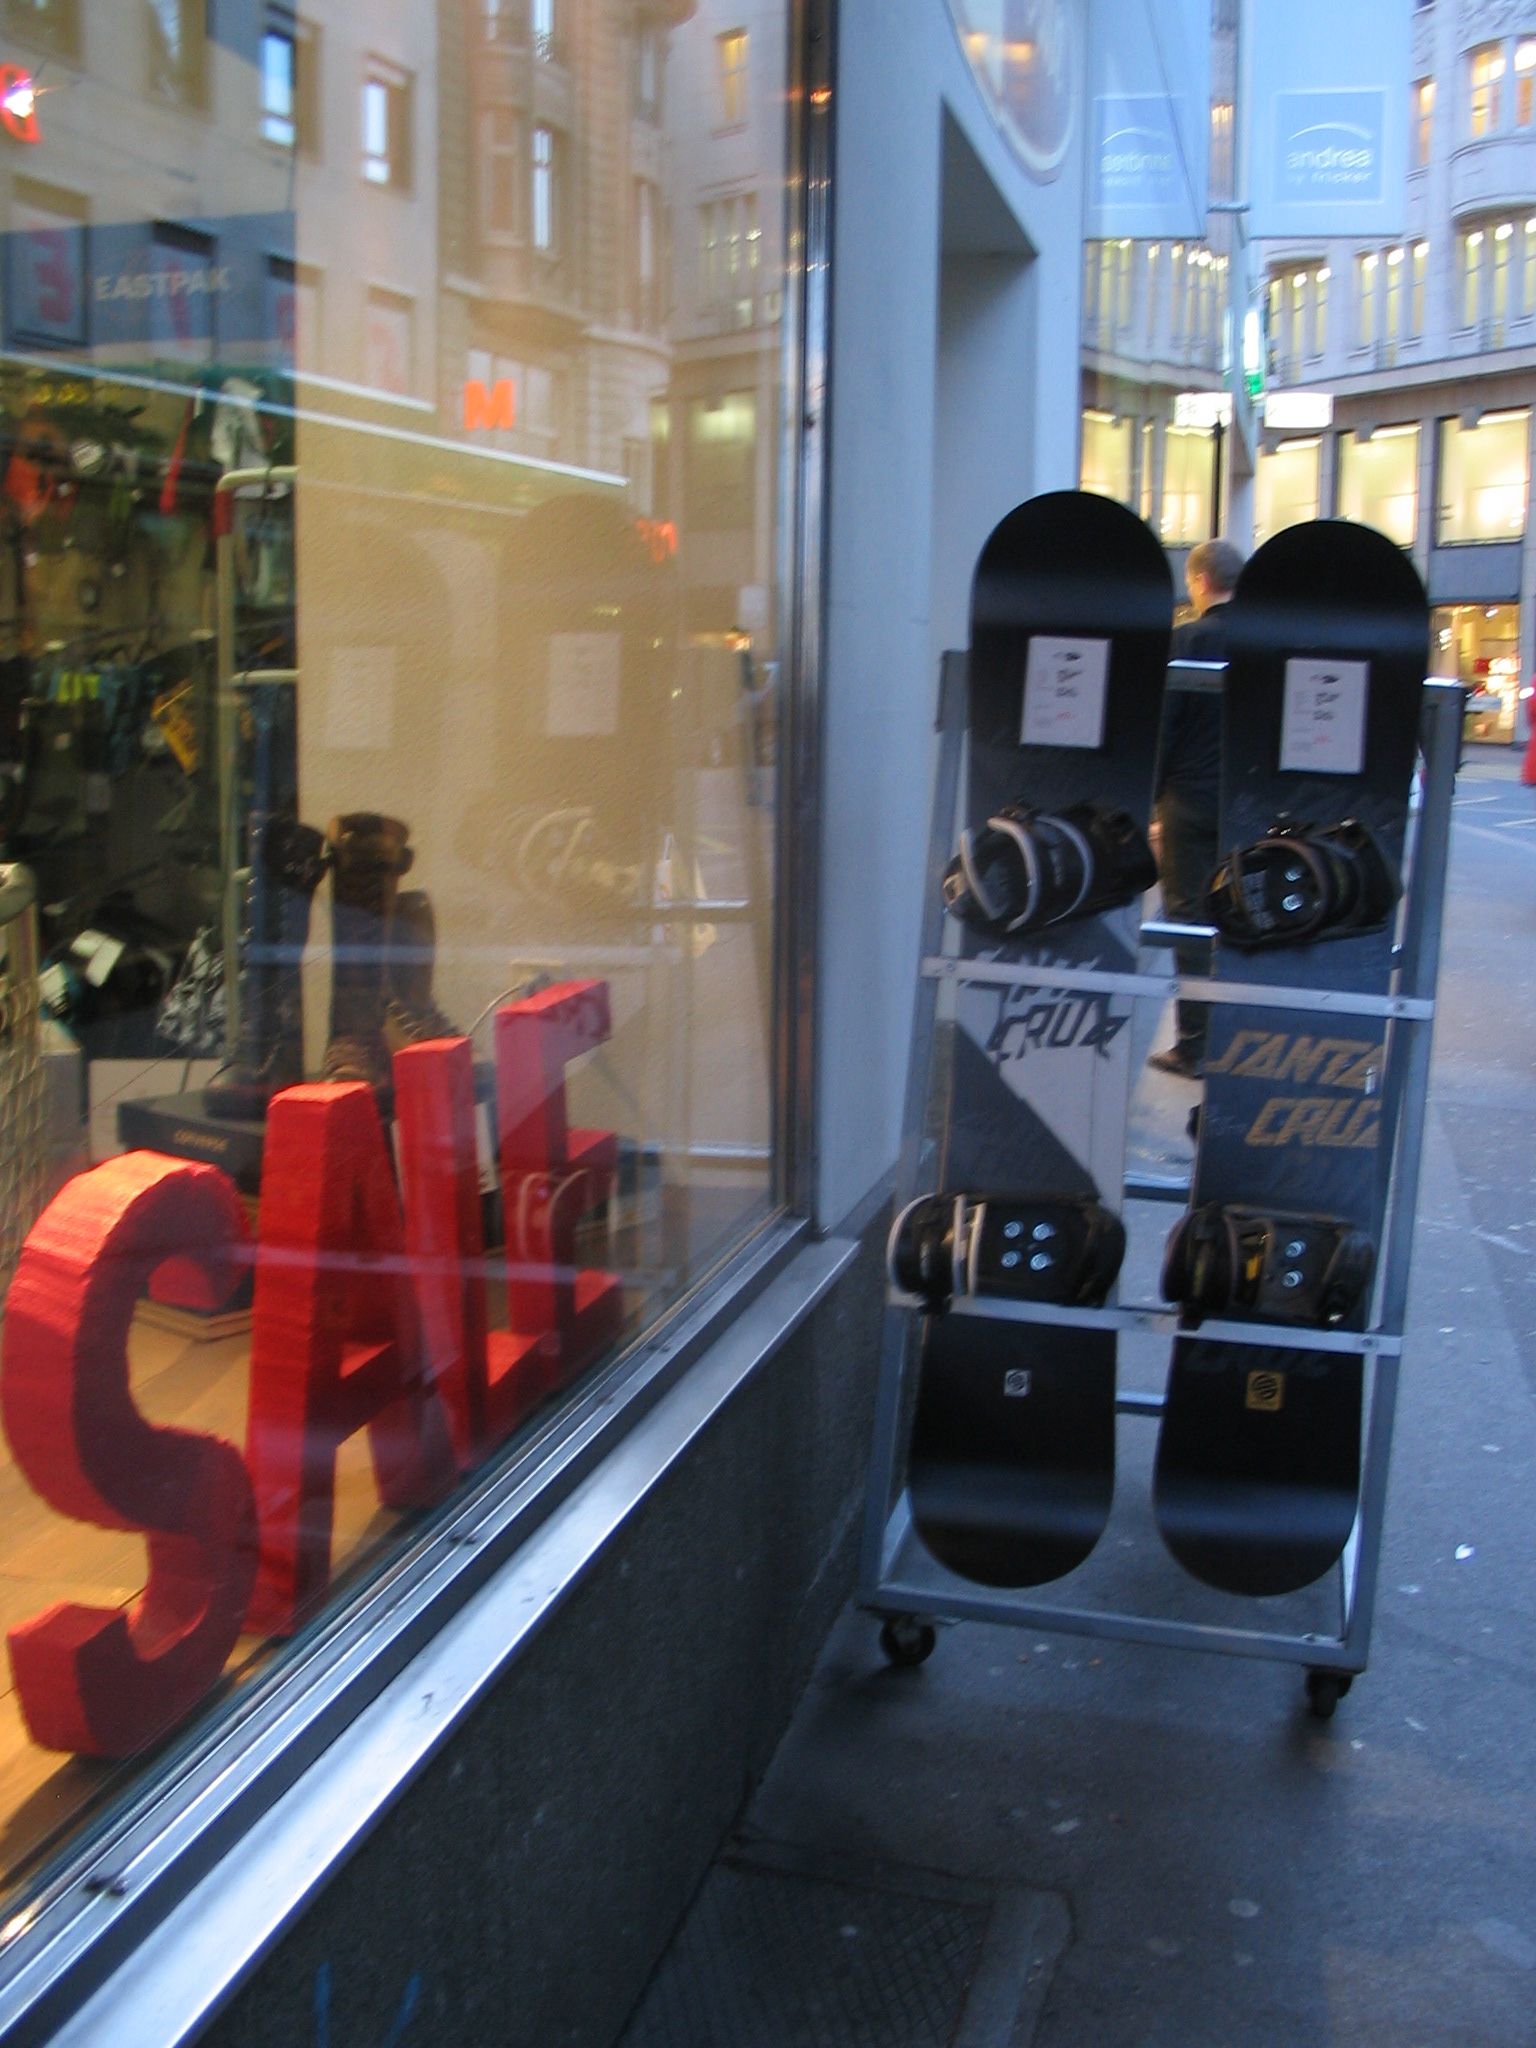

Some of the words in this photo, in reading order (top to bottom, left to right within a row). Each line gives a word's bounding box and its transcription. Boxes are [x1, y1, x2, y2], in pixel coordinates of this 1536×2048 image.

[1286, 145, 1372, 169] andrea
[94, 266, 232, 300] EASTPAK
[1203, 1031, 1386, 1090] SANTA
[3, 979, 622, 1756] SALE
